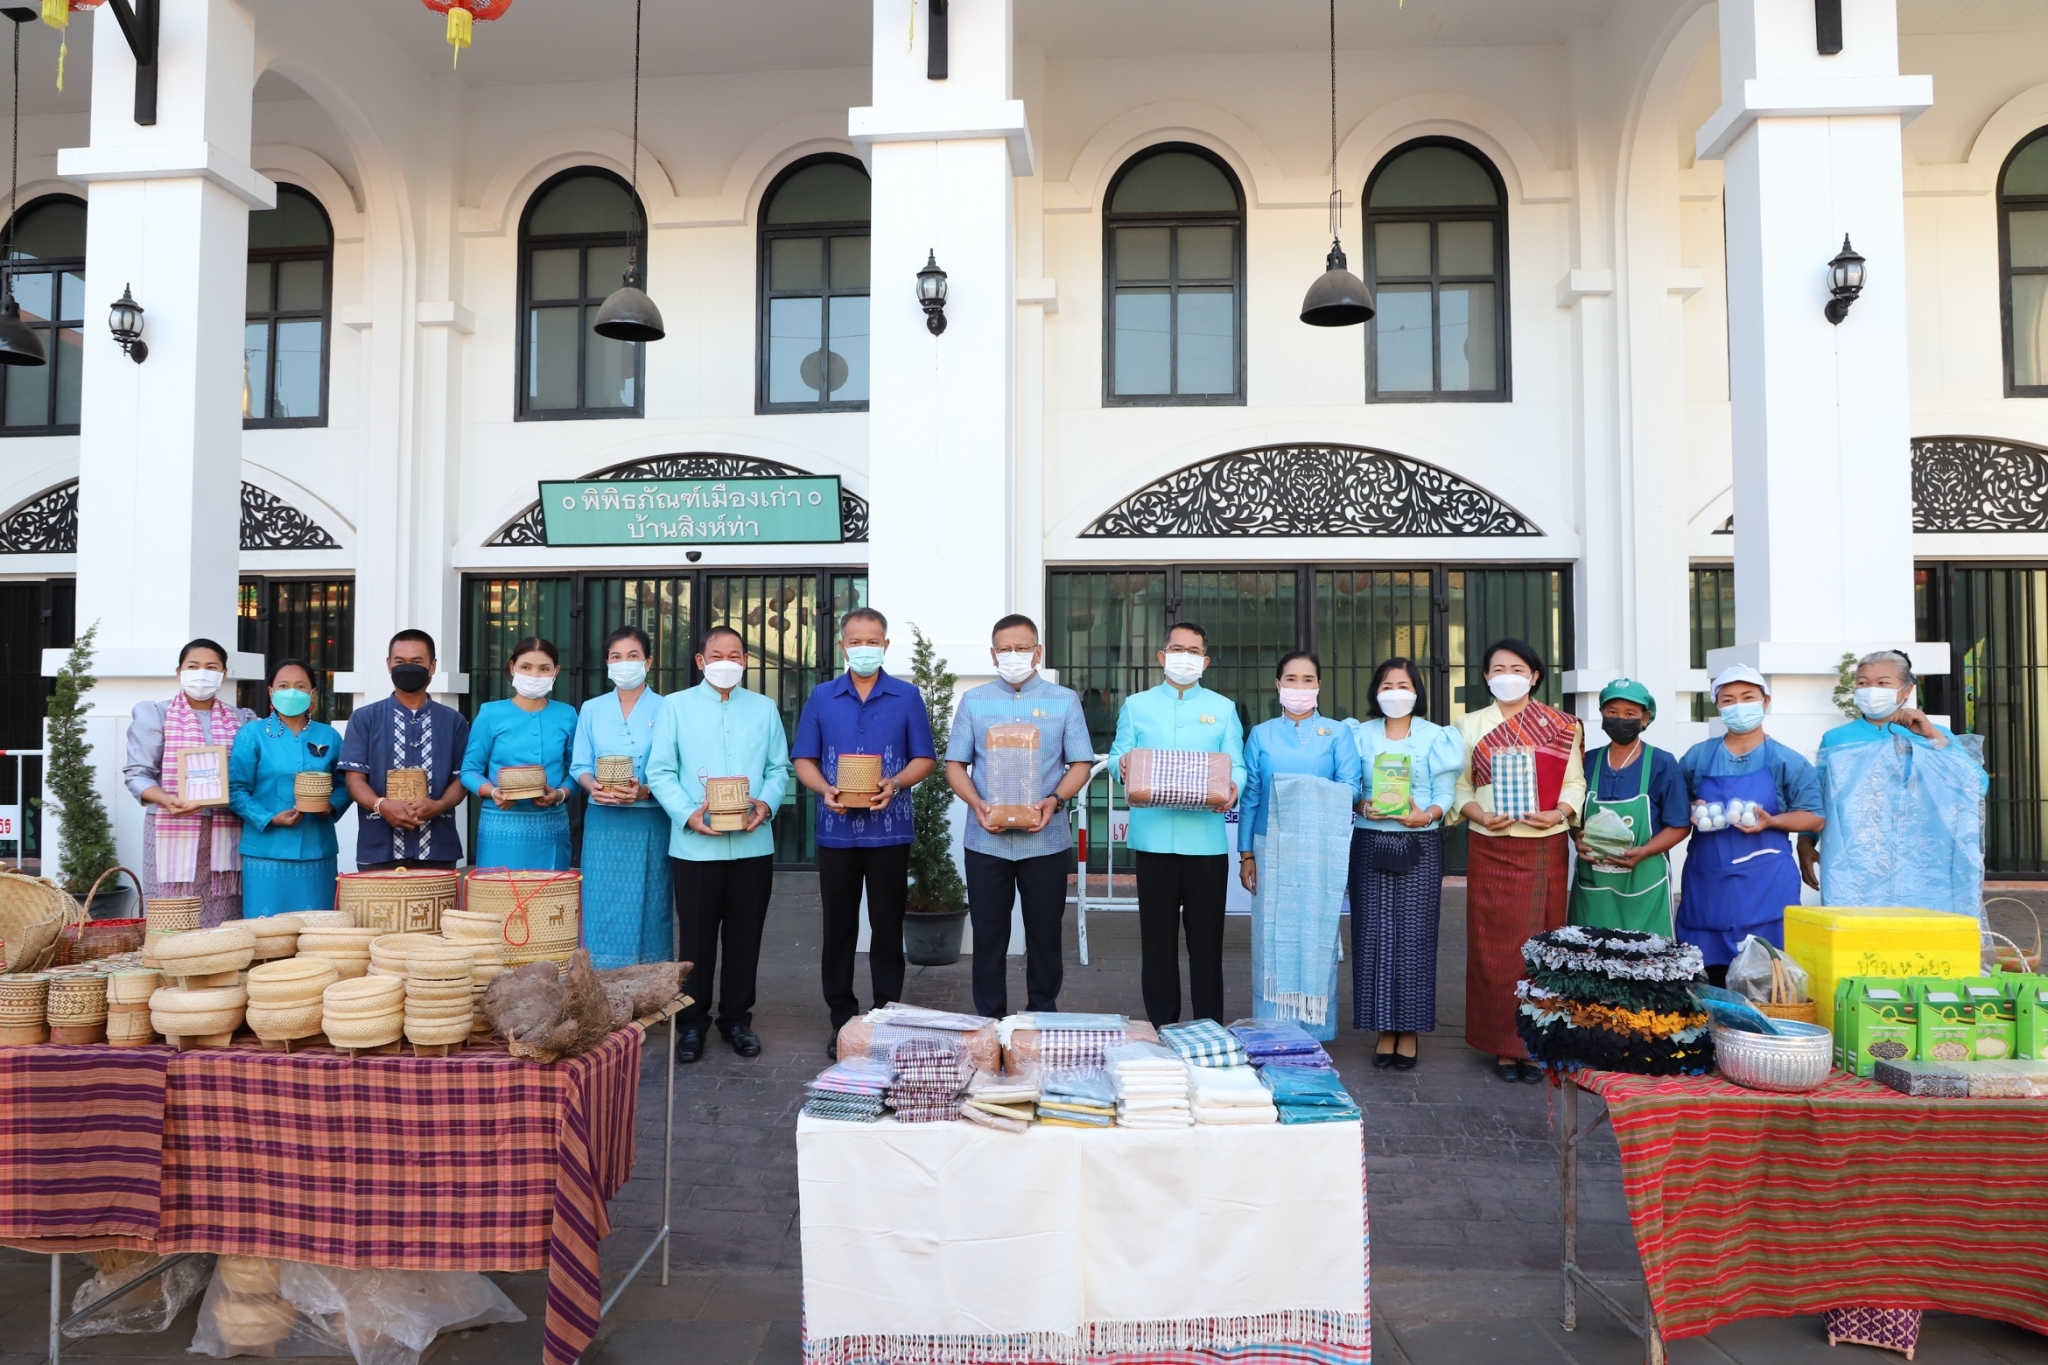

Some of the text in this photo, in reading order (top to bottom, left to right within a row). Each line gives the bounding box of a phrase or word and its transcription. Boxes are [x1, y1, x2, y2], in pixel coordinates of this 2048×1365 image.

[581, 483, 802, 511] พิพิธภัณฑ์เมืองเก่า
[627, 513, 759, 538] บ้านสิงห์ท่า
